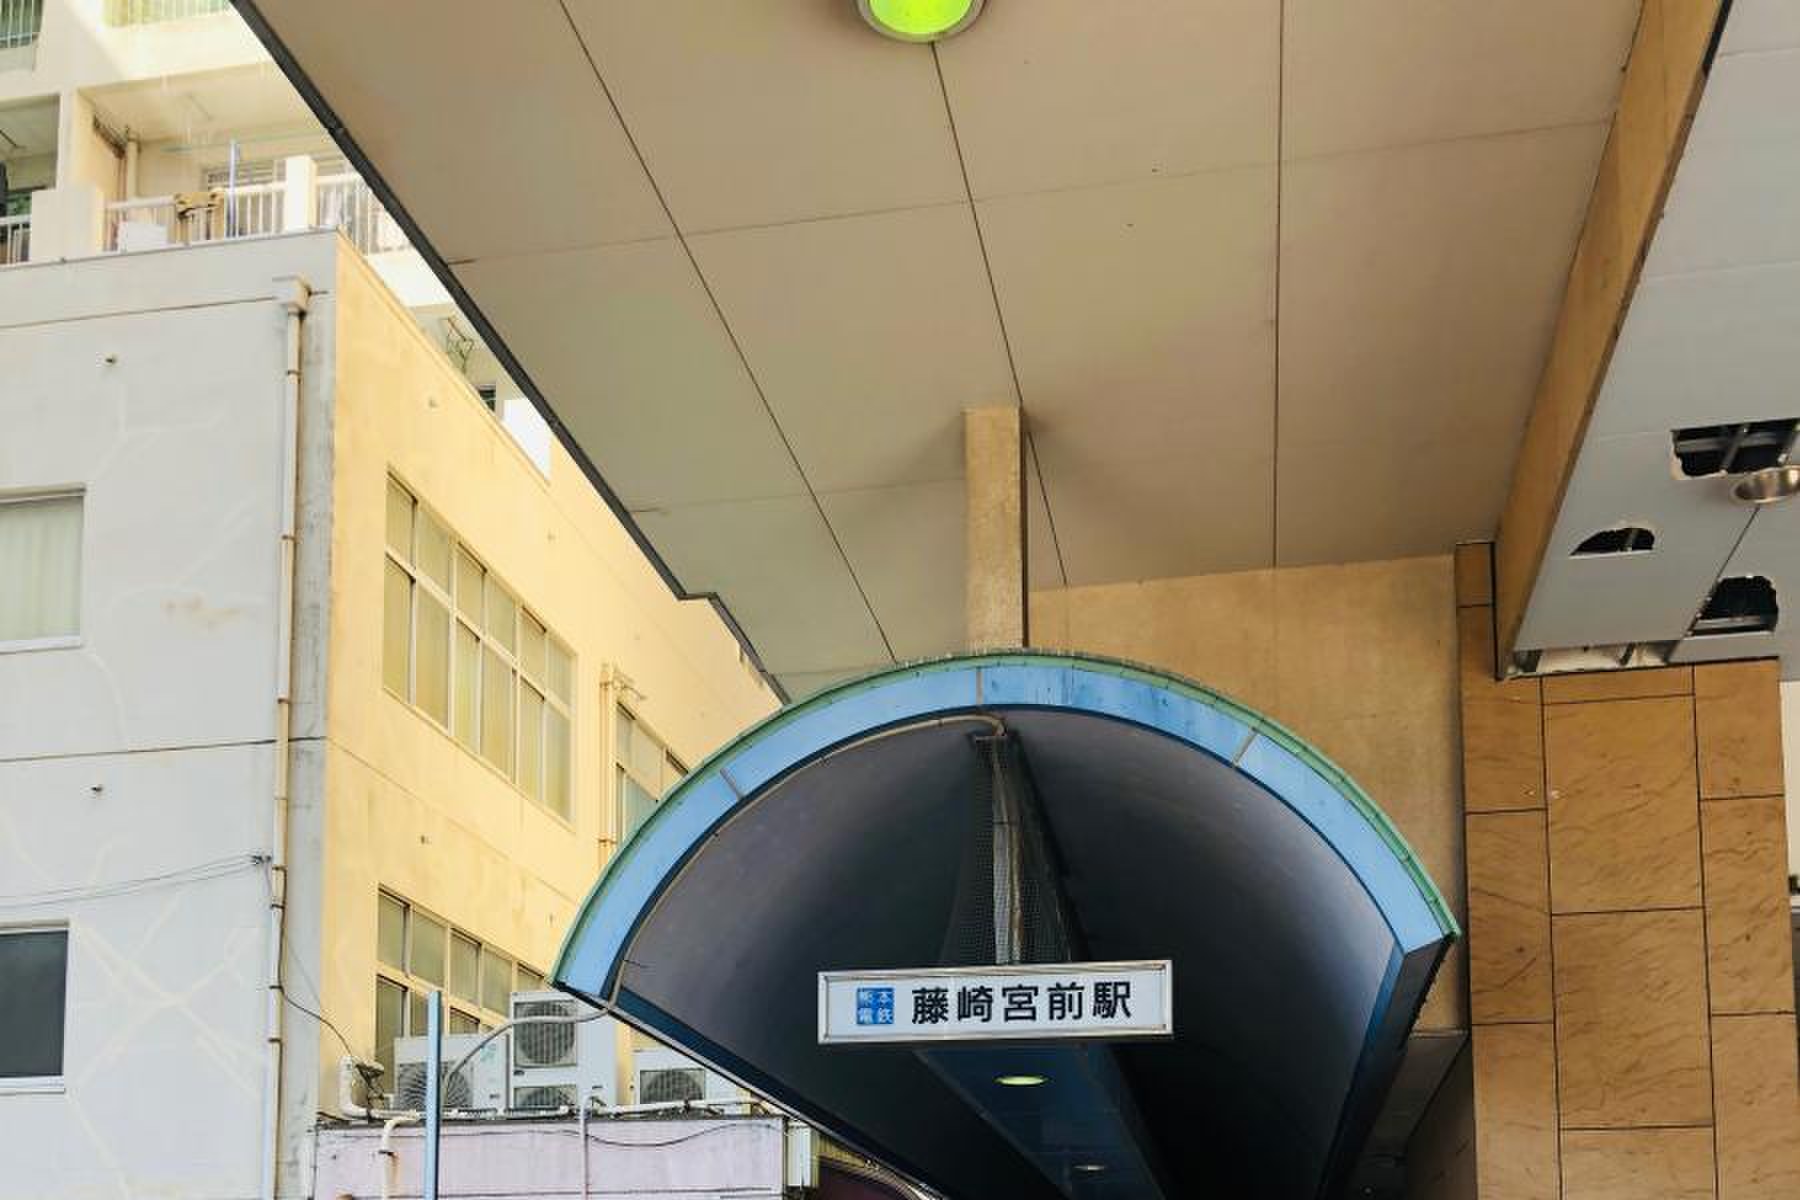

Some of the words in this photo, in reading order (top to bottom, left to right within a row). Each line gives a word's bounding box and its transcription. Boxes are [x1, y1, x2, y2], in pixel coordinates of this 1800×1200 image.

[911, 981, 1132, 1025] 藤崎宮前駅
